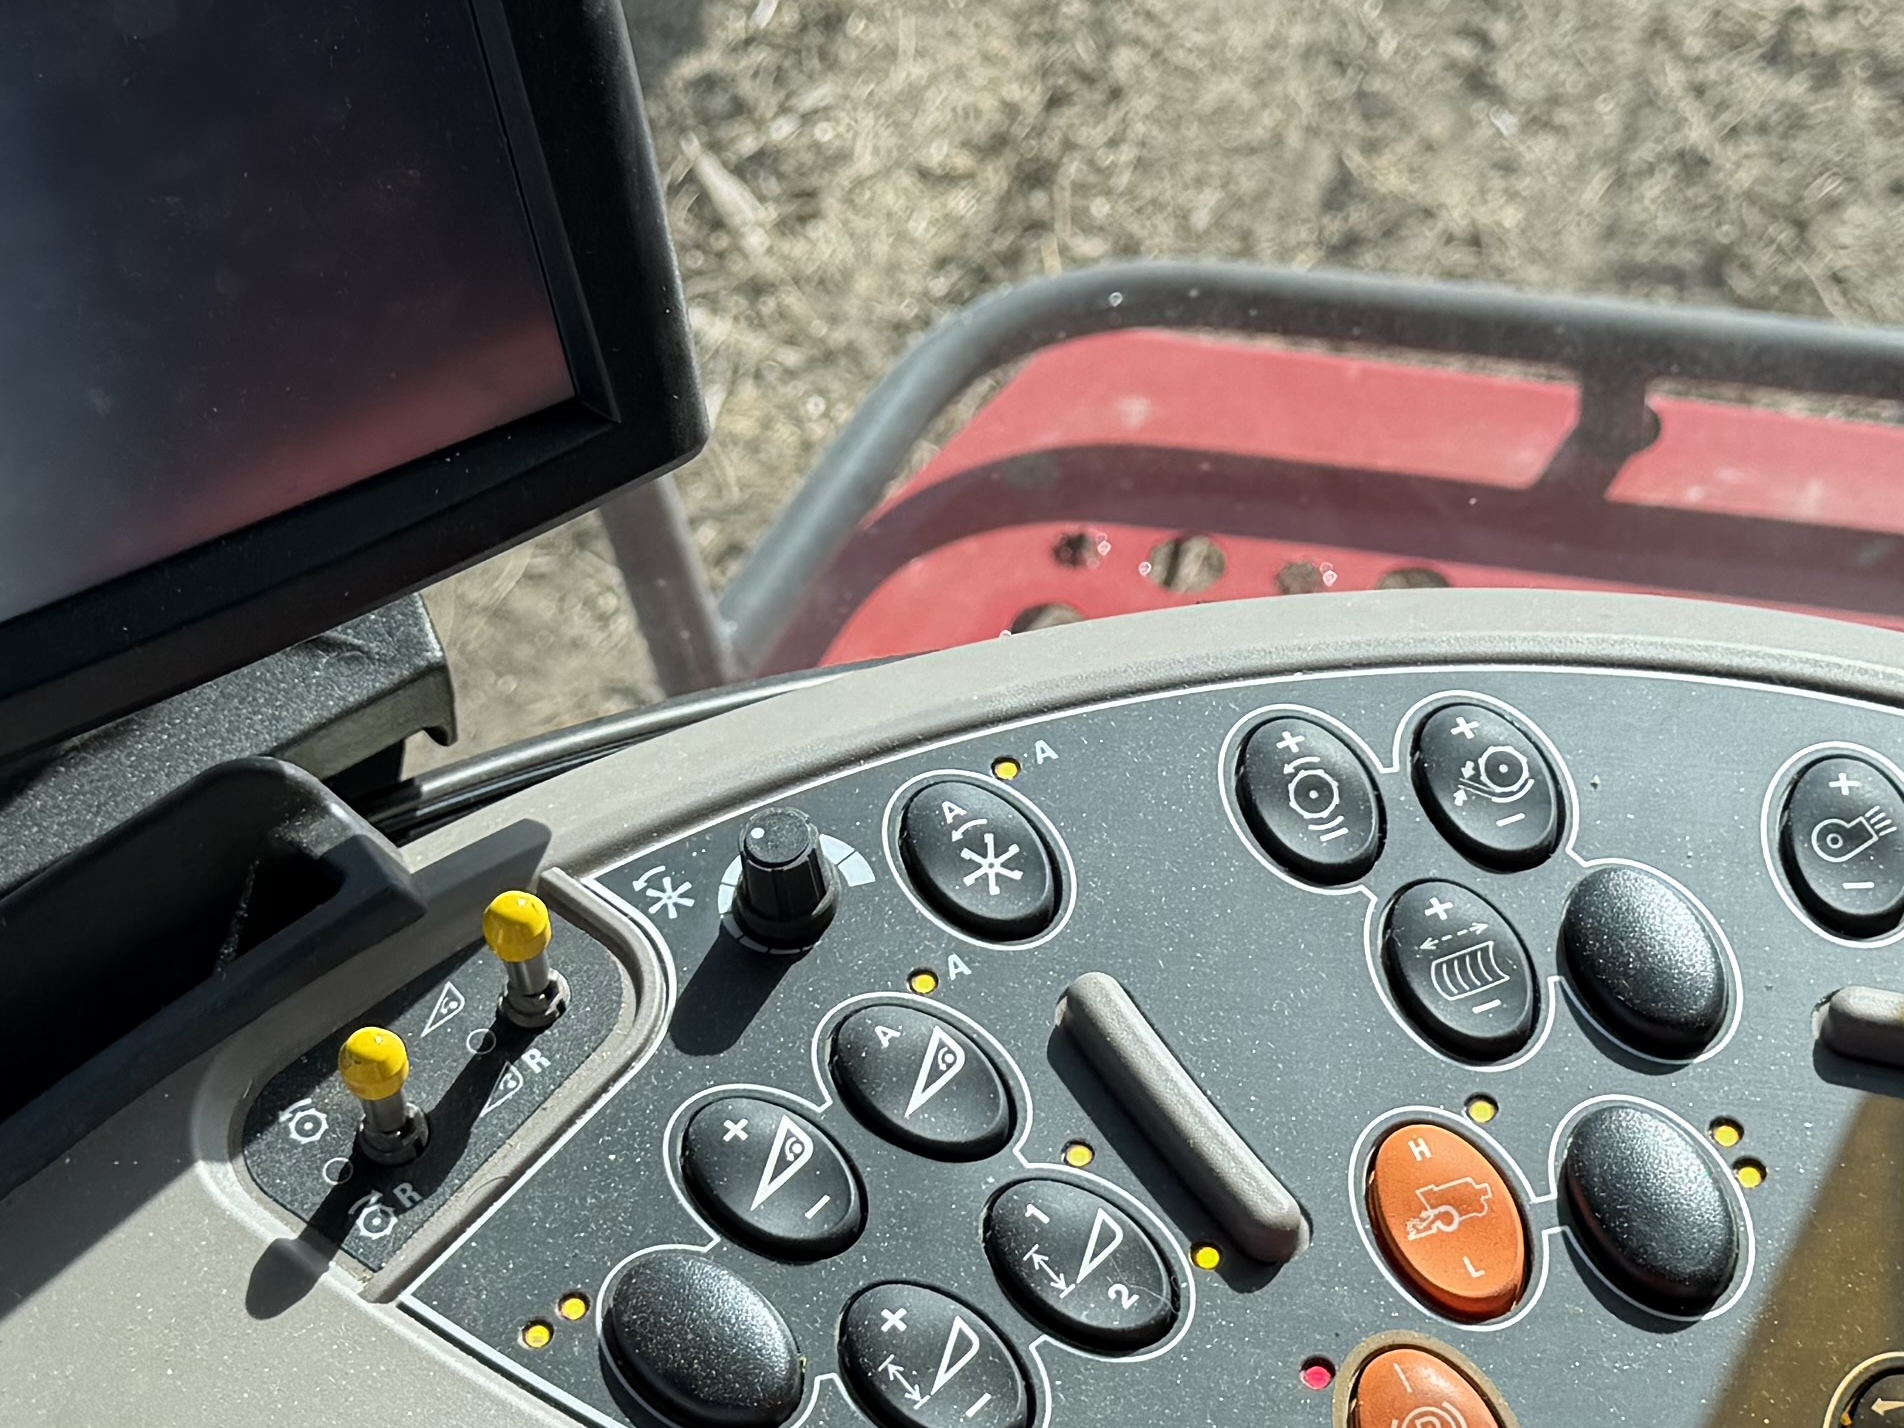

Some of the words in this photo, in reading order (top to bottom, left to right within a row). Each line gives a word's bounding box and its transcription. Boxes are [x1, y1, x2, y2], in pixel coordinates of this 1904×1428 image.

[1034, 739, 1059, 765] A
[941, 800, 967, 825] A
[947, 953, 972, 981] A
[874, 1025, 902, 1049] A
[521, 1047, 552, 1075] R
[1407, 1136, 1432, 1162] H
[393, 1181, 424, 1209] R
[1024, 1203, 1051, 1225] 1
[1462, 1256, 1486, 1280] L
[1107, 1283, 1140, 1310] 2
